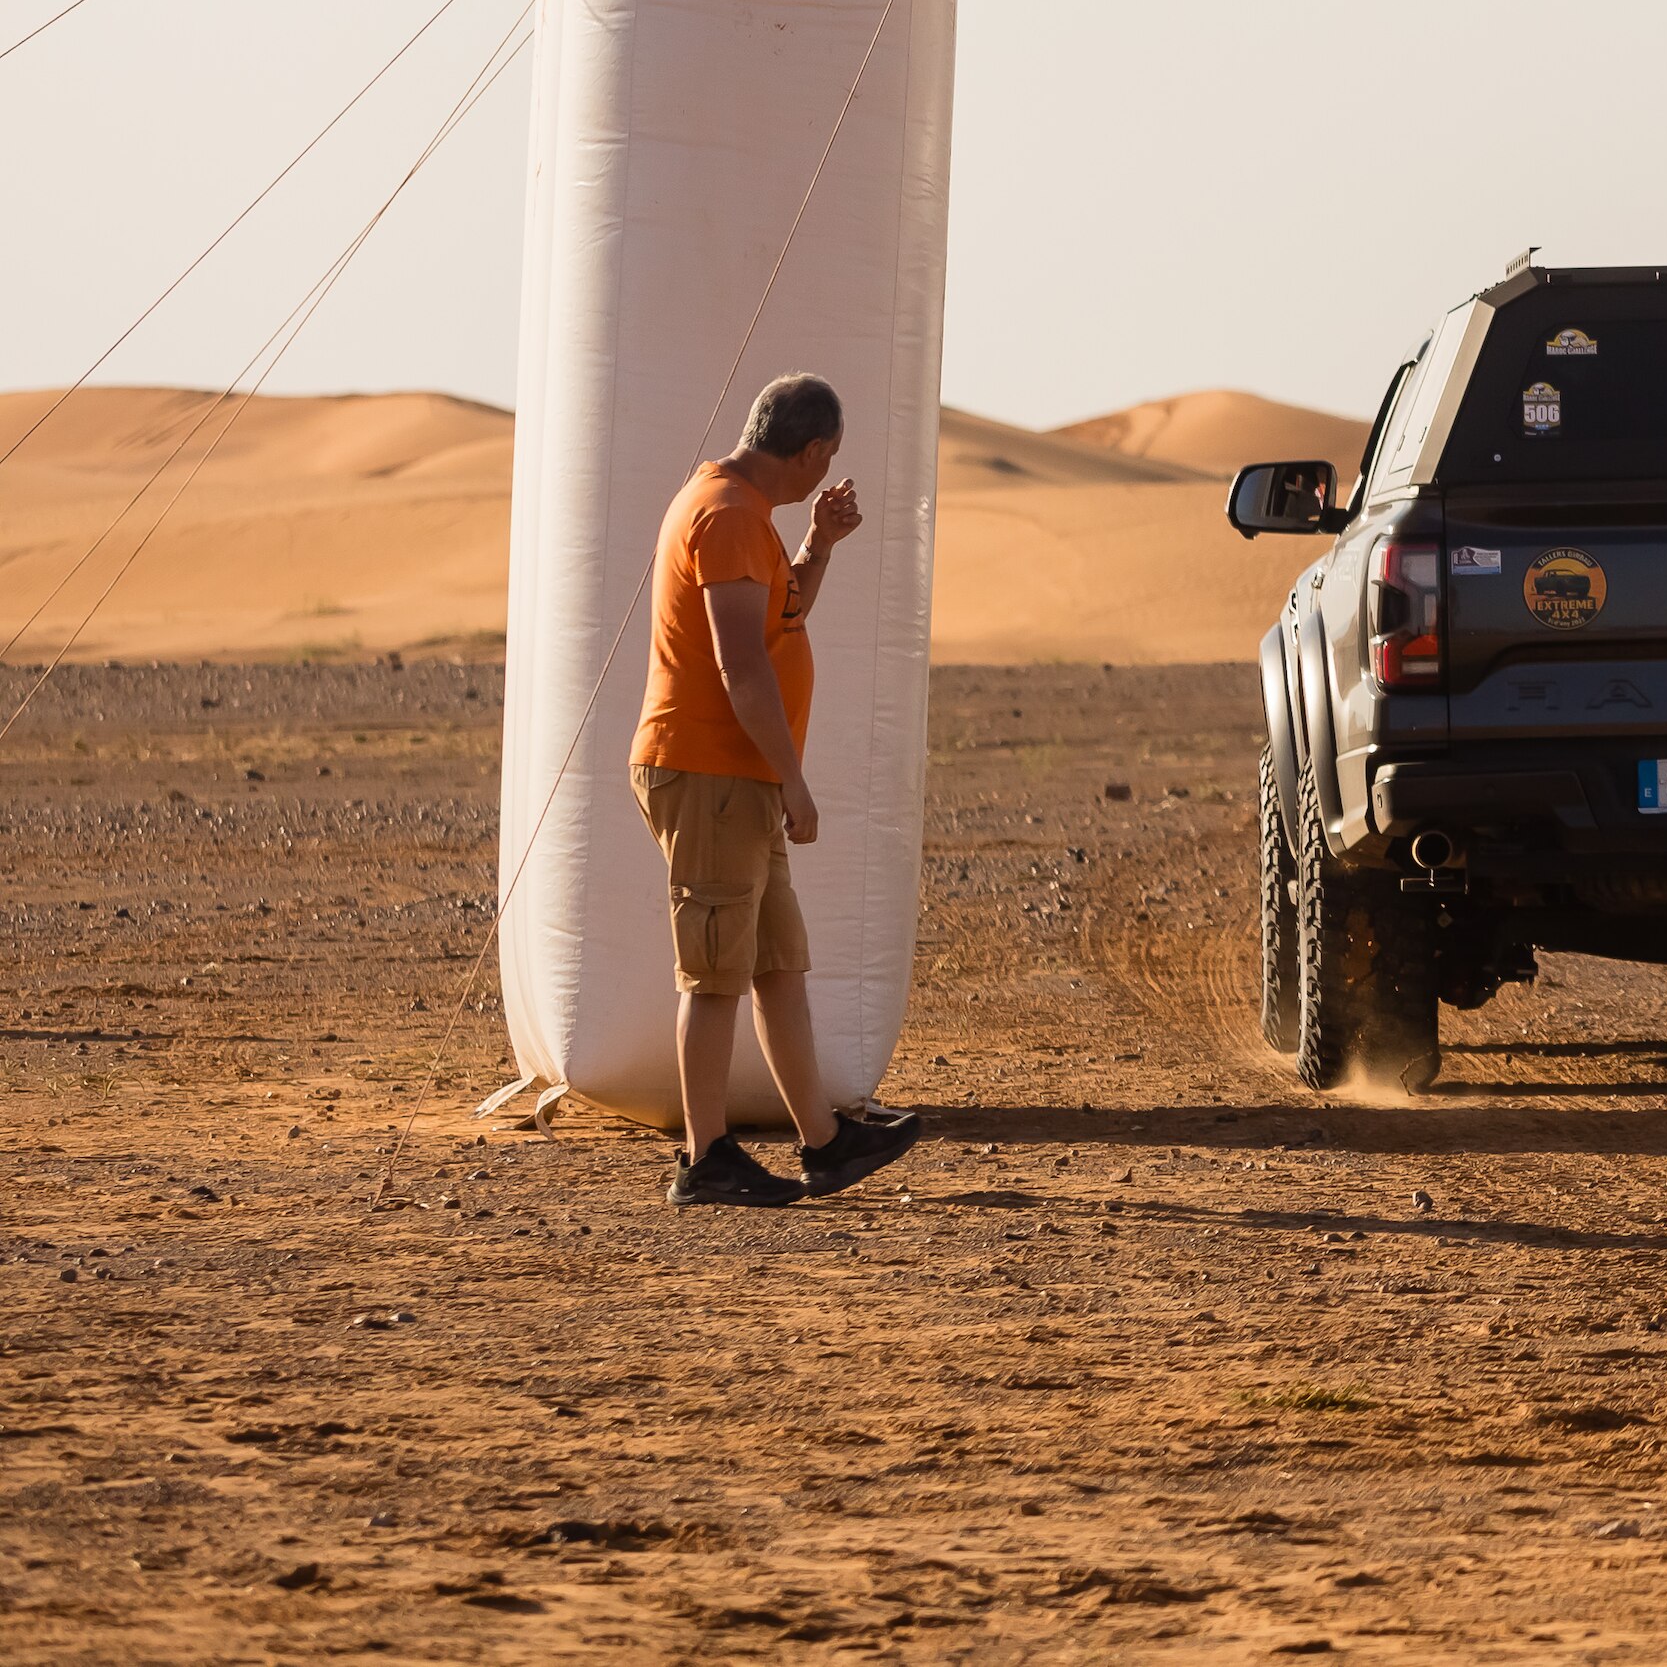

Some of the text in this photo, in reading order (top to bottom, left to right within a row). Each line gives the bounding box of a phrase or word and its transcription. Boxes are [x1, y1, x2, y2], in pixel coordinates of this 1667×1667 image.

[1524, 404, 1560, 423] 506
[1537, 600, 1594, 611] EXTREME
[1644, 787, 1653, 798] E
